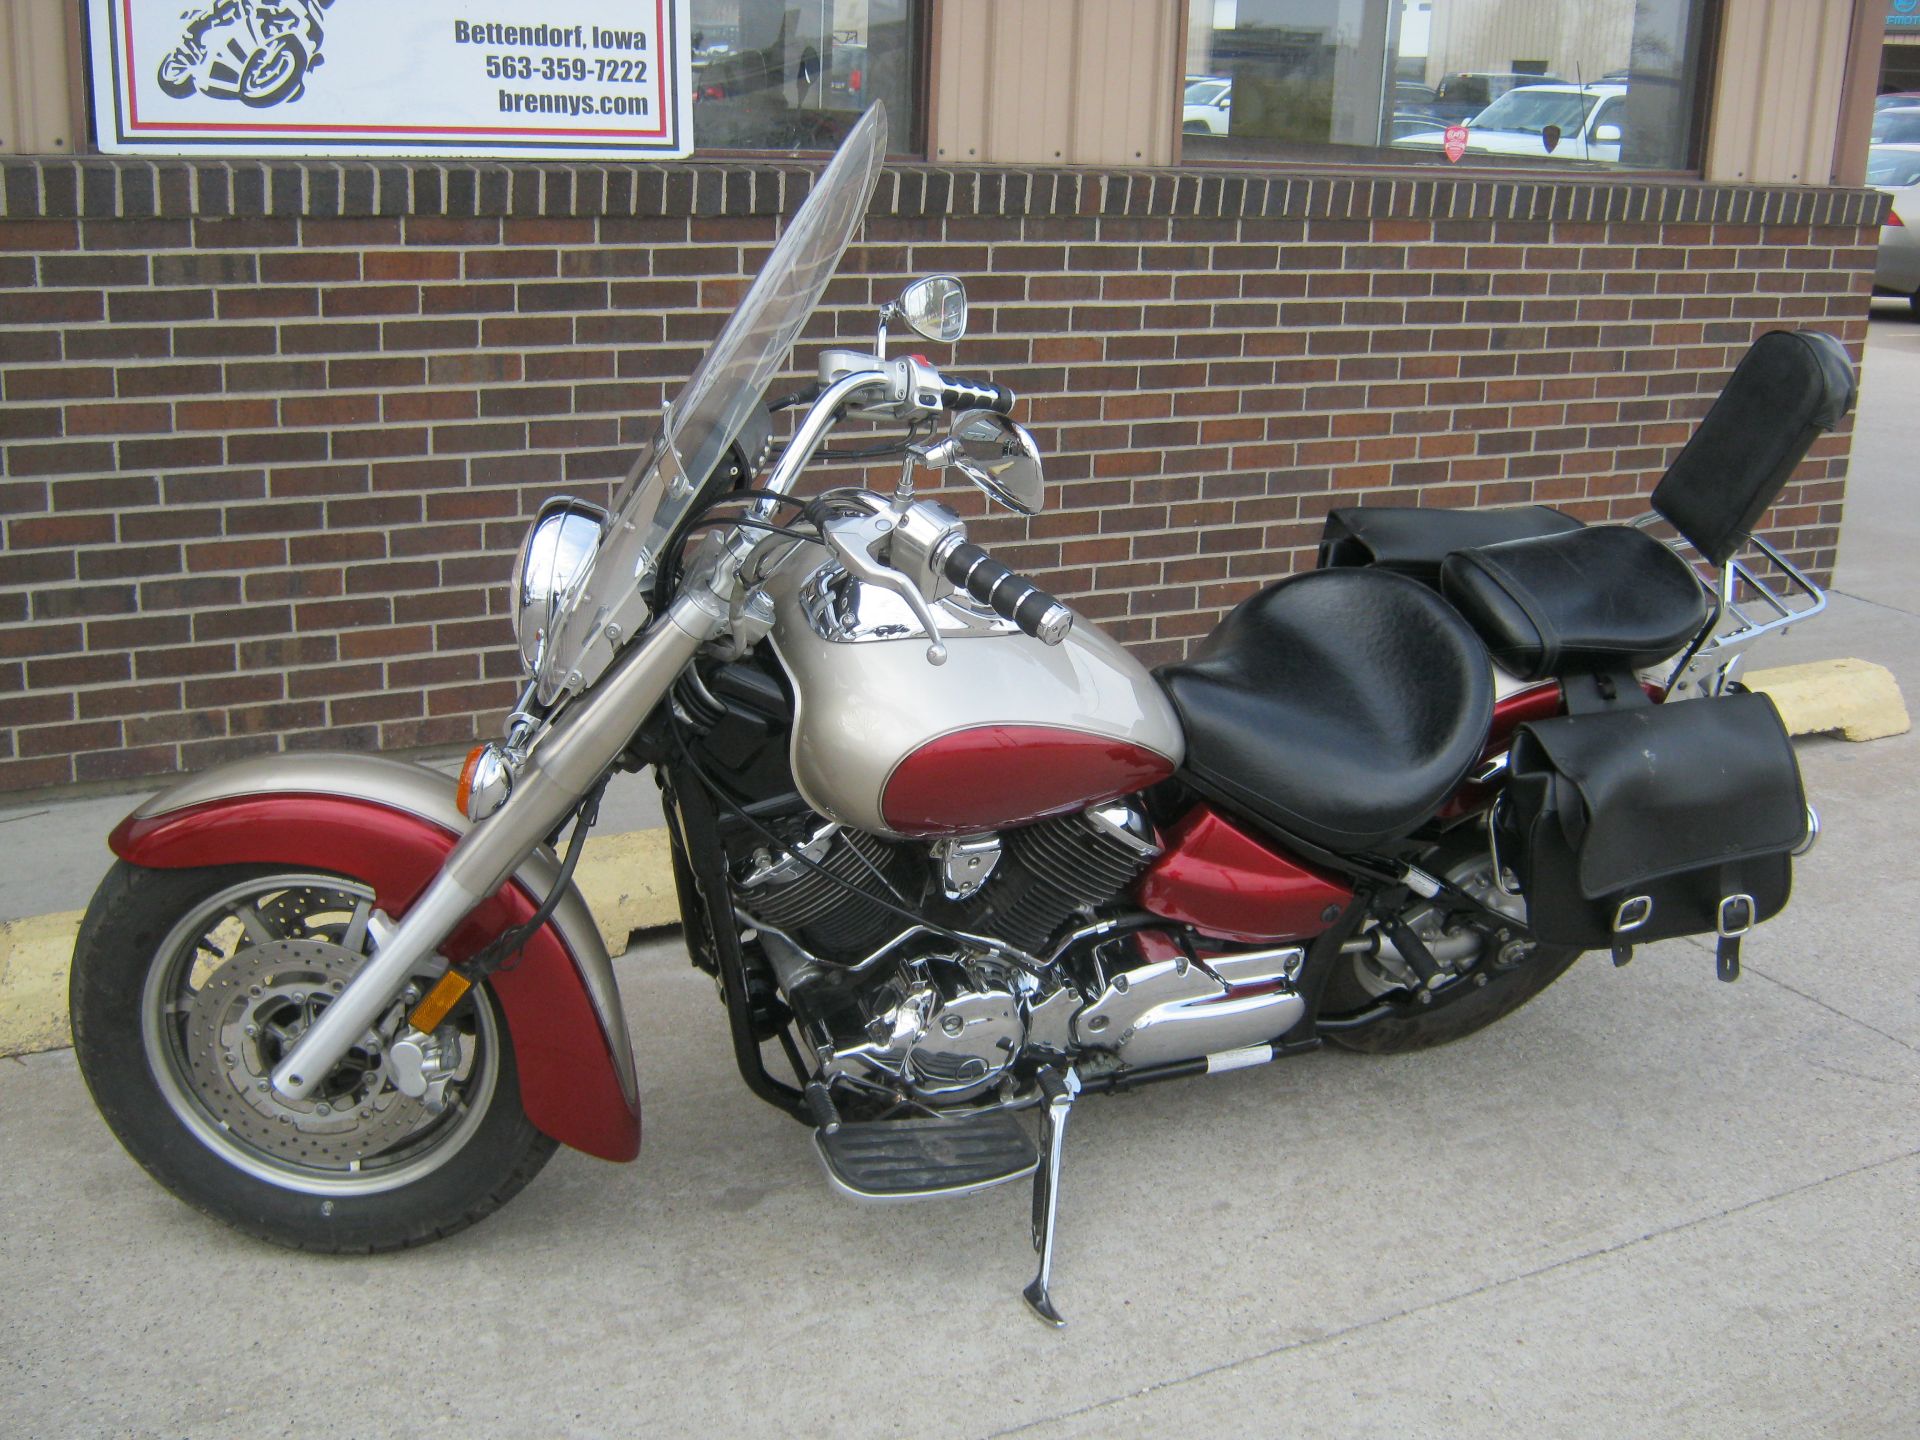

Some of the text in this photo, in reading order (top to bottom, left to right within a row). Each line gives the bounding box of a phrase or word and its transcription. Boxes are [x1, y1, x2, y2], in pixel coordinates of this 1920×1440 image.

[455, 20, 647, 51] Bettendorf, Iowa
[486, 55, 647, 83] 563-359-7222
[499, 89, 649, 117] brennys.com
